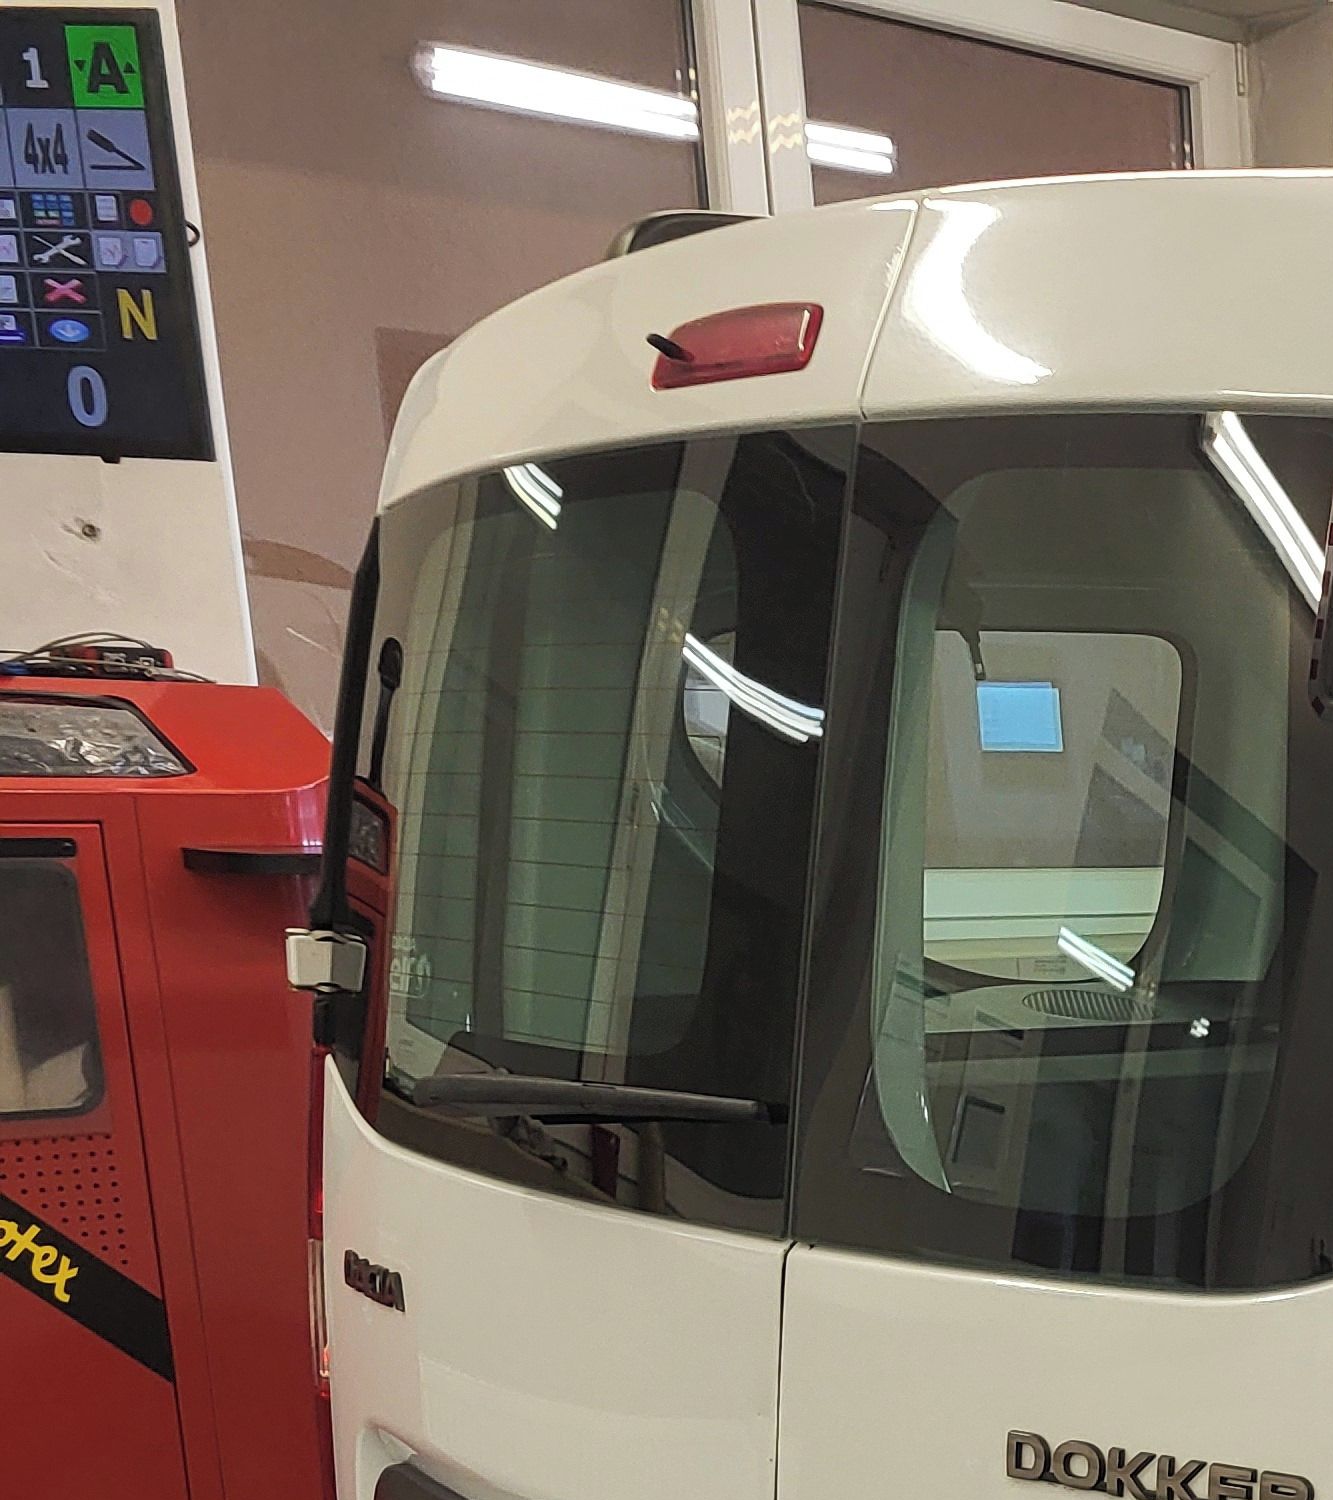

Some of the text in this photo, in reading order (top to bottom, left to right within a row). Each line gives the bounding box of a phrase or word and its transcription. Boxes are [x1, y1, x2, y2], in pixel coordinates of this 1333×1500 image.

[22, 41, 129, 95] 1 A
[24, 123, 69, 176] 4x4
[117, 288, 159, 341] N
